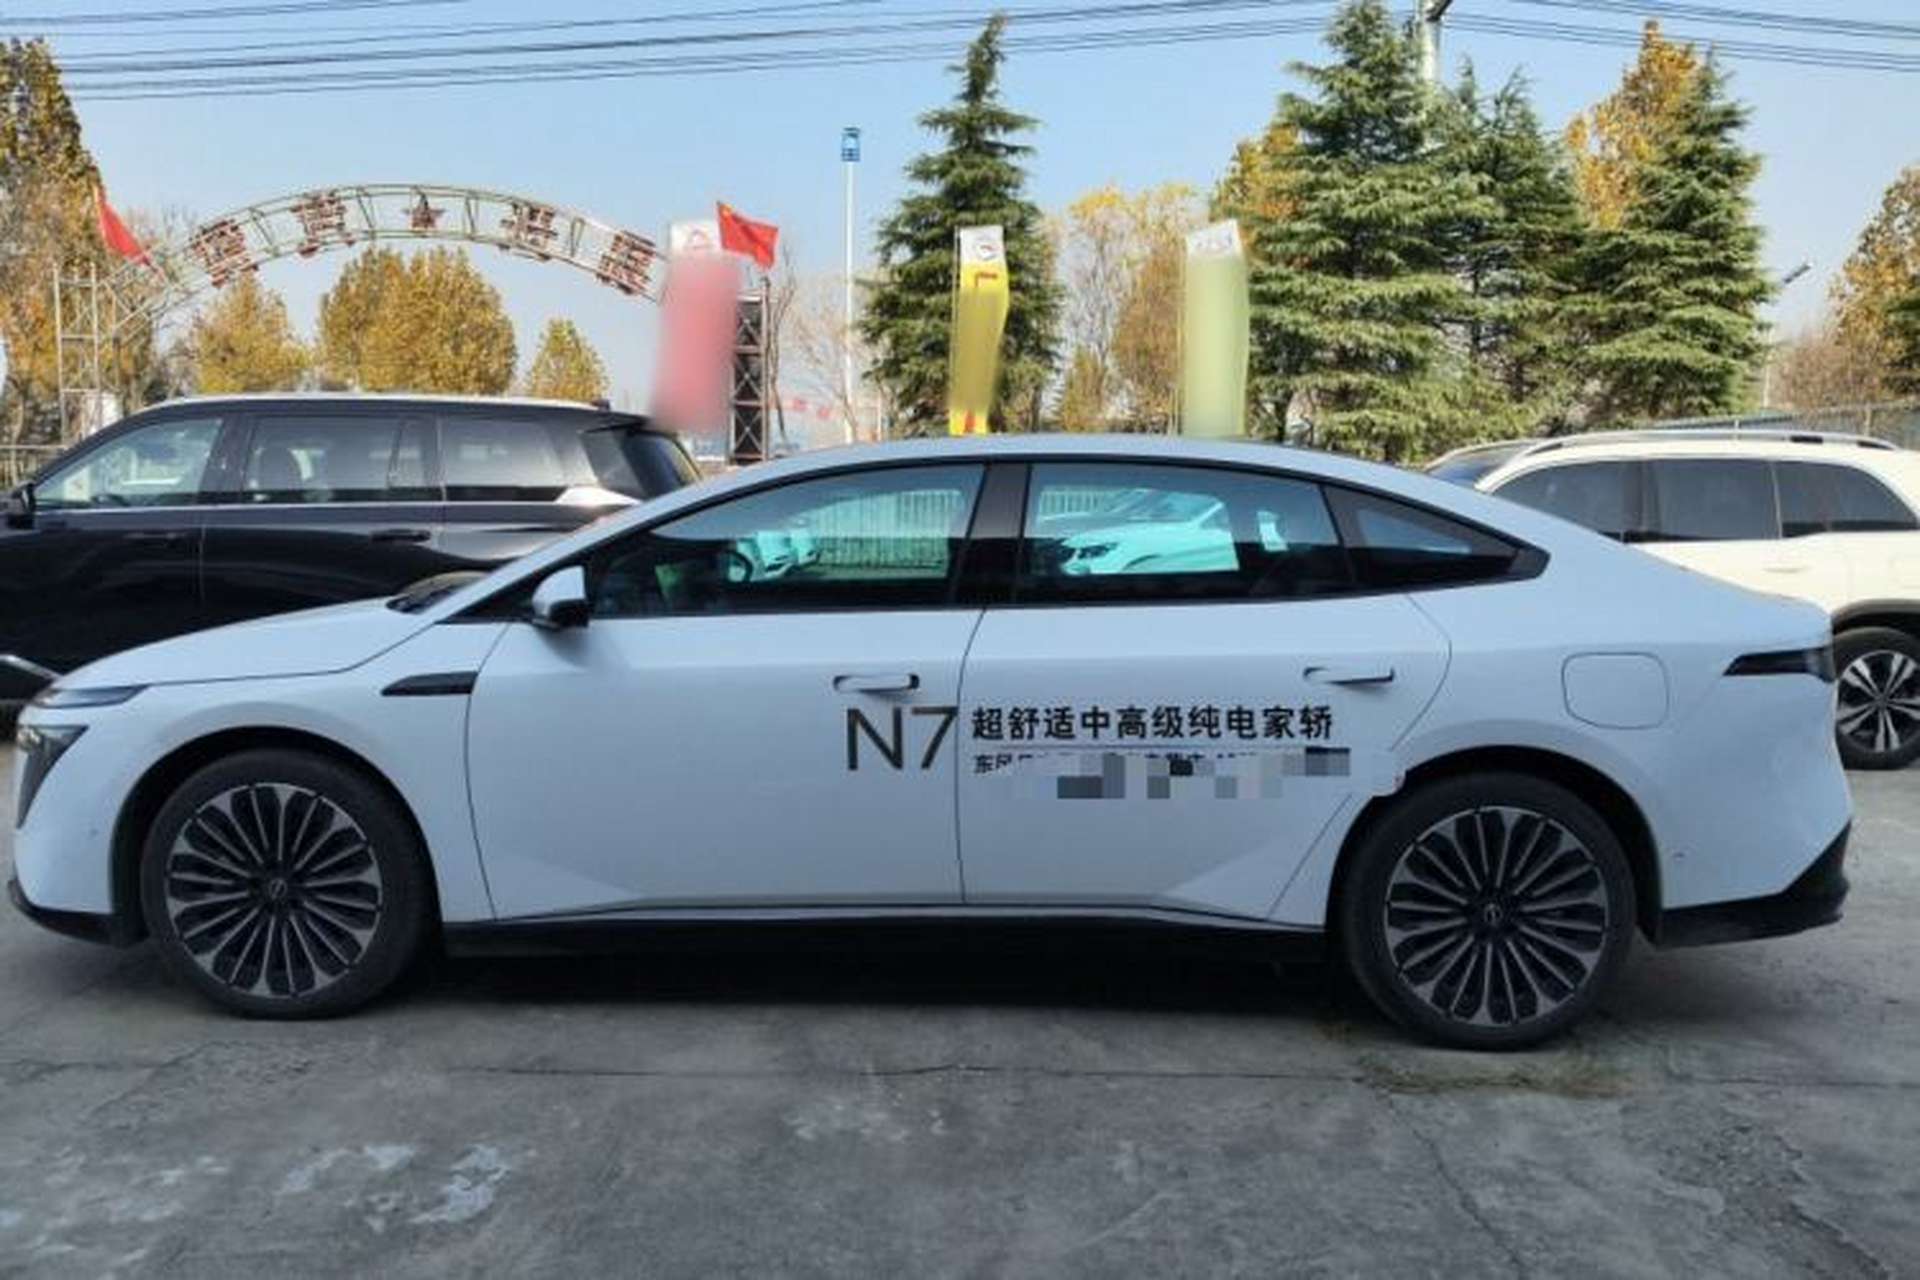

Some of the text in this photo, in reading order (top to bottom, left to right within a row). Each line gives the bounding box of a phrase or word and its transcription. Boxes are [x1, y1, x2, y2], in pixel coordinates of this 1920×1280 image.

[847, 706, 959, 771] N7
[972, 705, 1333, 740] 超舒适中高级纯电家轿
